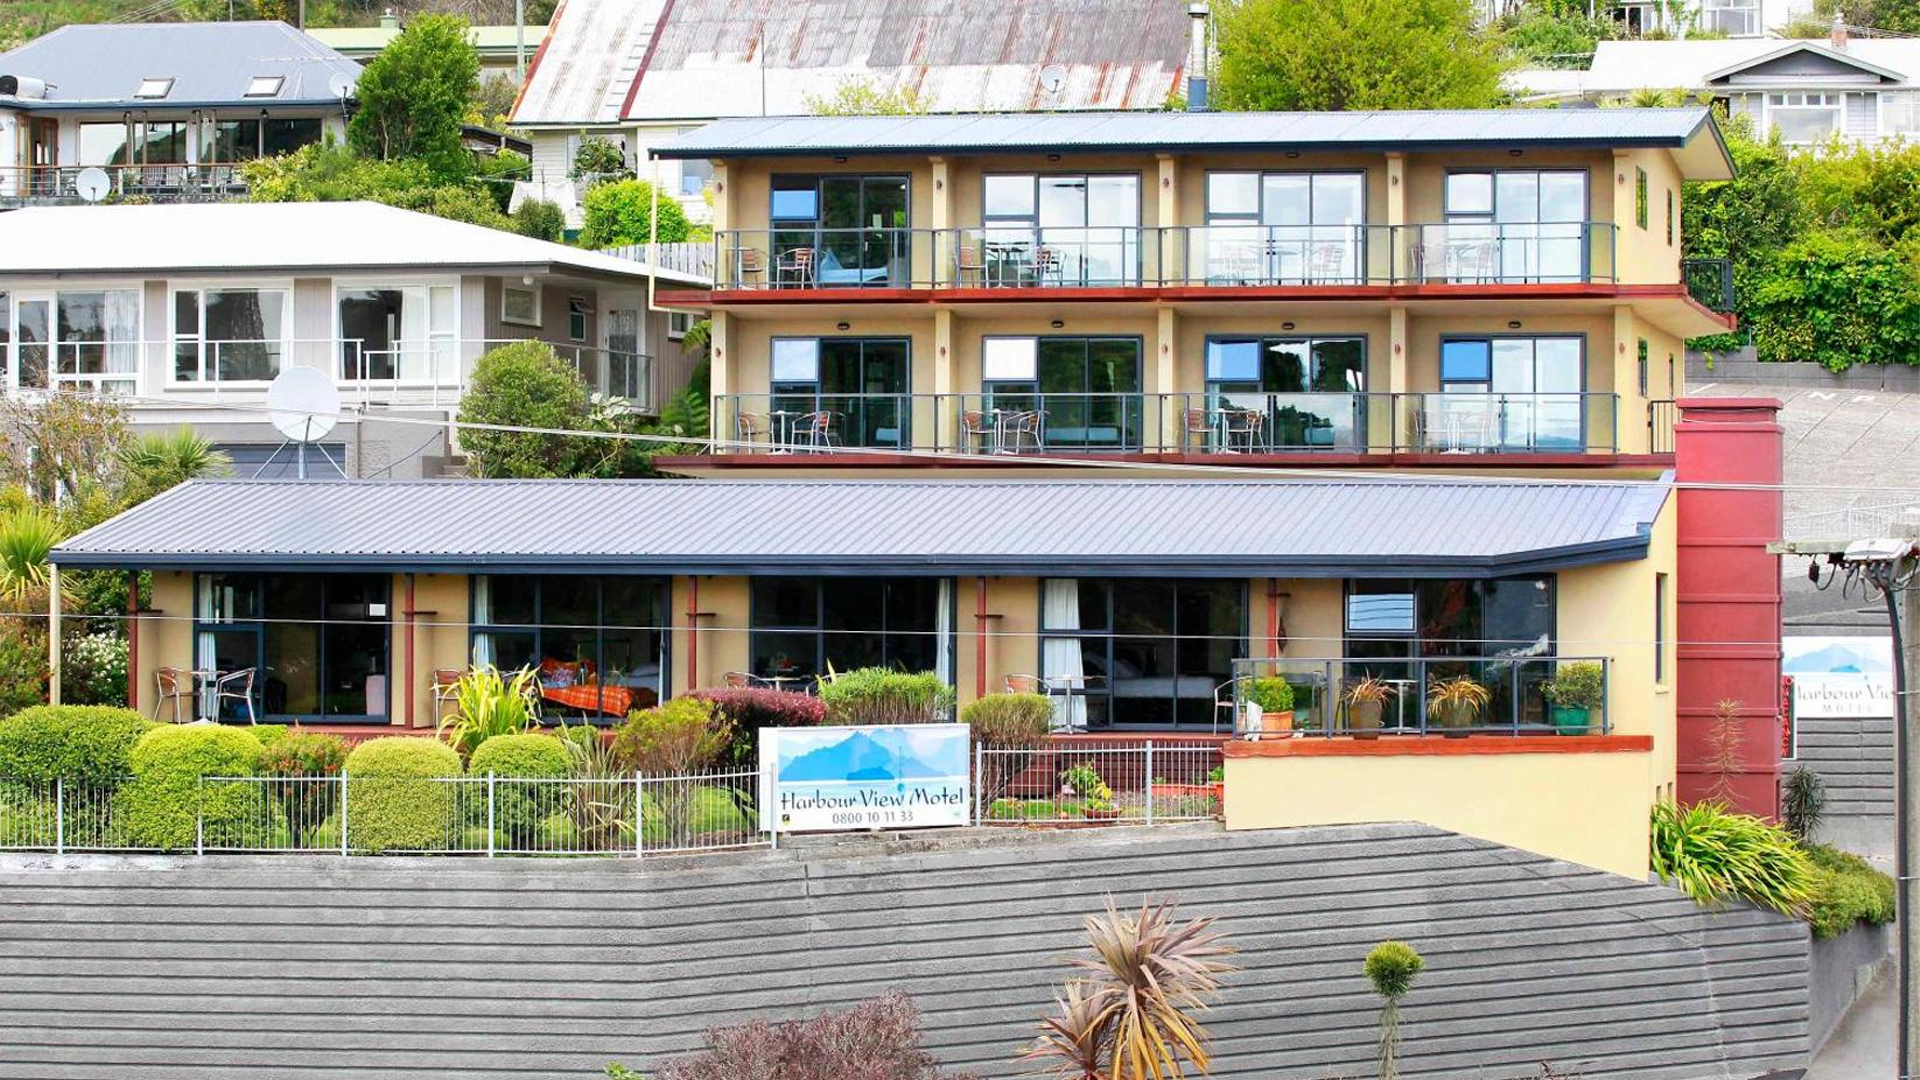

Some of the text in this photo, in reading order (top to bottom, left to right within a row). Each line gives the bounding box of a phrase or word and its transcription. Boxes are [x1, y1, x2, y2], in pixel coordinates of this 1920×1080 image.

[781, 787, 963, 810] Harbour View Motel
[832, 810, 914, 824] 0800 10 11 33
